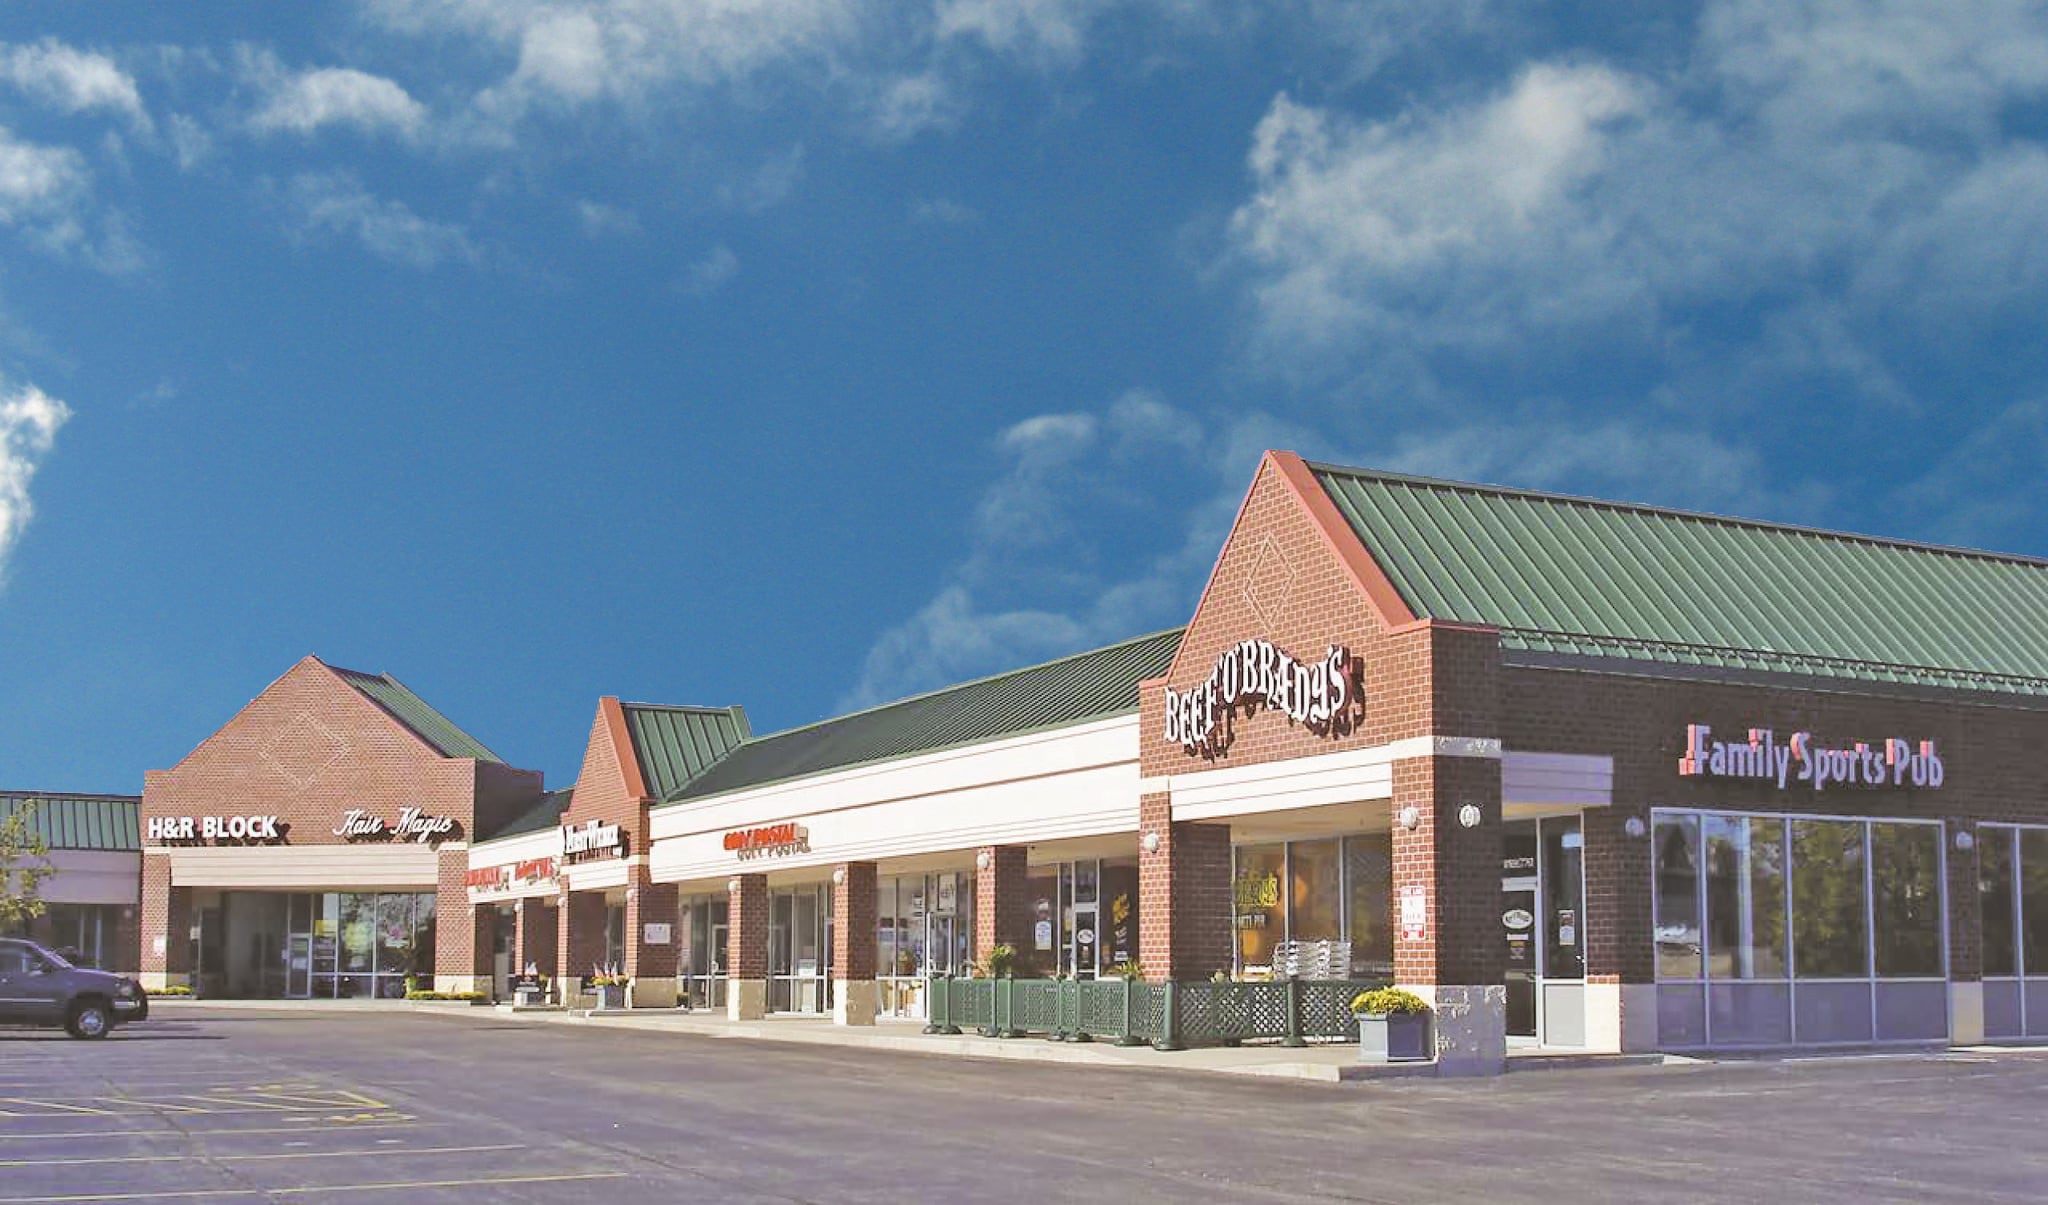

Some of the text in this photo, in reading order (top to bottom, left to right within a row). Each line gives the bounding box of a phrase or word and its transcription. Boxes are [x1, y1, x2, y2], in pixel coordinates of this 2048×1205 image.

[1165, 656, 1221, 748] BEEF
[1686, 724, 1944, 790] Family Sports Pub
[148, 816, 279, 839] H&R BLOCK
[333, 806, 453, 843] Hair Magic
